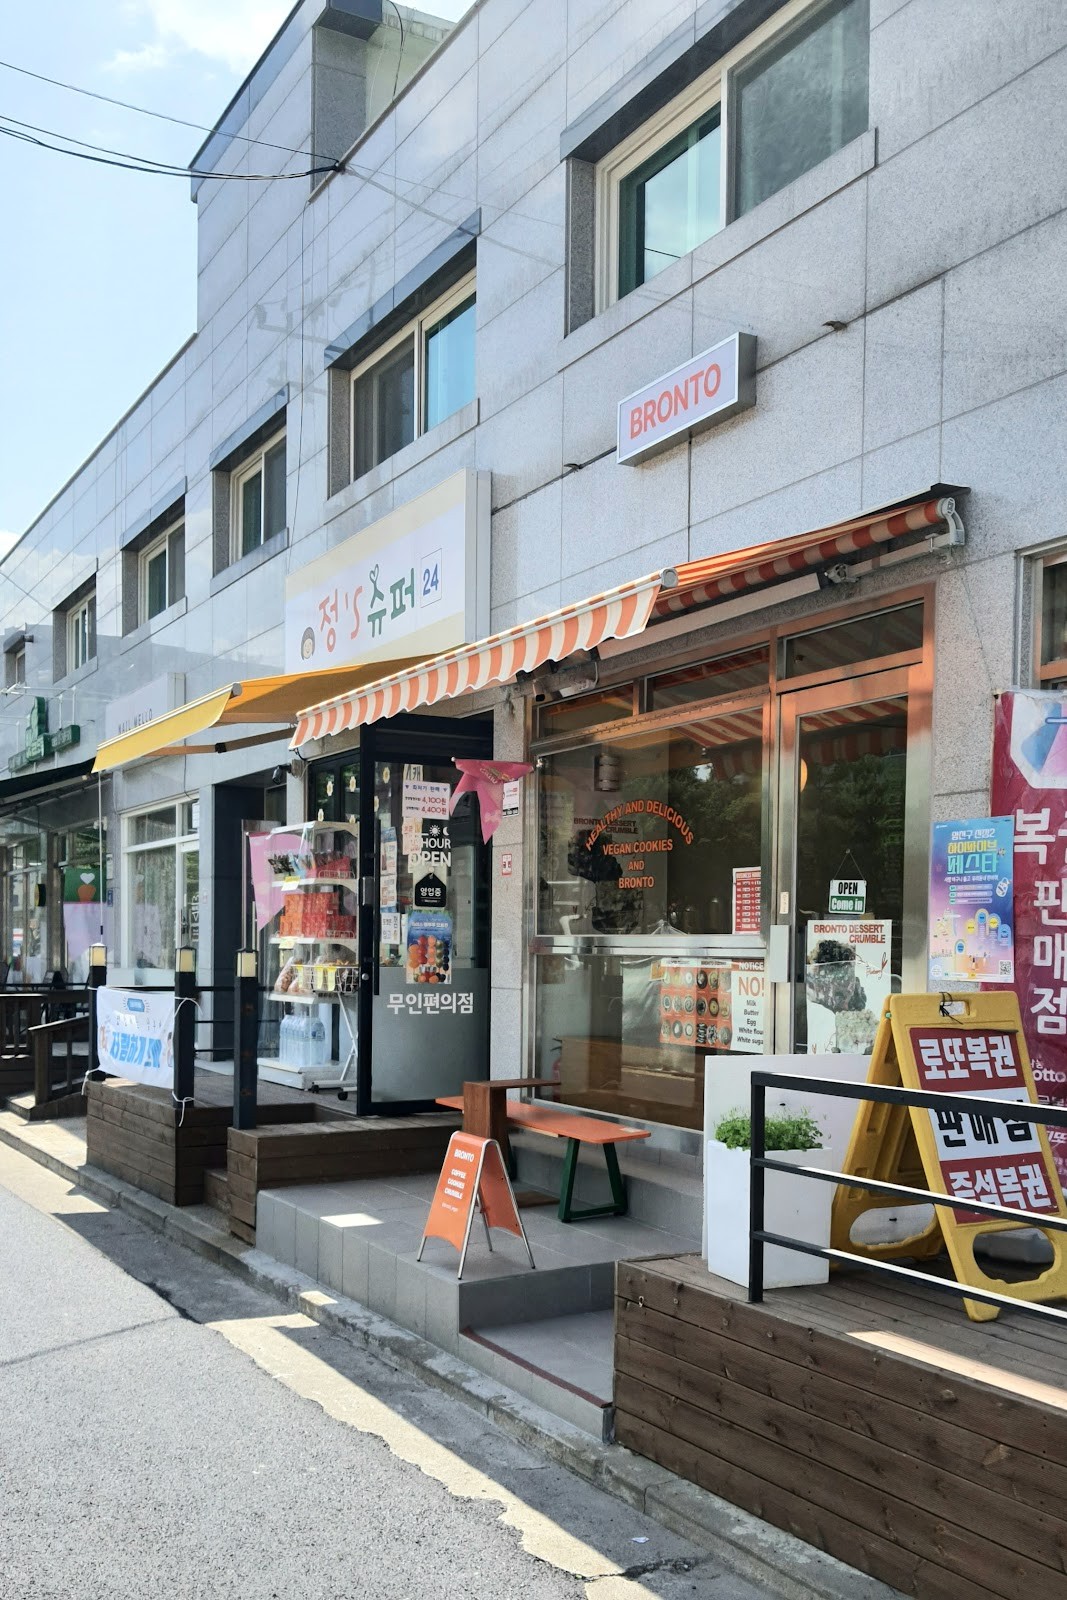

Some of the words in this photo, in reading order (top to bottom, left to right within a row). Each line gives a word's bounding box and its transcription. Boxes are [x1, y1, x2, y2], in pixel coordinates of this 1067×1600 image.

[630, 363, 721, 440] BRONTO
[367, 563, 415, 638] 슈퍼
[422, 563, 439, 596] 24
[585, 804, 624, 851] HEALTHY
[624, 799, 645, 815] AND
[646, 799, 694, 845] DELICIOUS
[421, 837, 451, 849] HOUR
[602, 842, 632, 856] VEGAN
[633, 838, 673, 853] COOKIES
[947, 839, 998, 855] 하이파이브
[409, 850, 451, 867] OPEN
[627, 860, 645, 871] AND
[946, 852, 999, 875] 페스타
[618, 876, 655, 889] BRONTO
[837, 881, 858, 895] OPEN
[420, 887, 442, 897] 영업중
[831, 897, 854, 911] Come
[854, 898, 863, 911] in
[813, 924, 847, 933] BRONTO
[849, 924, 884, 933] DESSERT
[849, 934, 886, 943] CRUMBLE
[738, 962, 764, 970] NOTICE
[738, 976, 764, 997] NO!
[387, 992, 474, 1015] 무인편의점
[743, 1008, 759, 1016] Butter
[746, 1018, 757, 1027] Egg
[738, 1026, 753, 1034] White
[753, 1027, 764, 1035] flou
[736, 1035, 751, 1043] White
[752, 1038, 764, 1046] suga
[918, 1035, 1018, 1080] 로또복권
[1032, 1068, 1066, 1083] otto
[453, 1149, 475, 1163] BRONTO
[451, 1168, 472, 1179] COFFEE
[447, 1177, 470, 1189] COOKIES
[948, 1163, 1052, 1210] 즉석복권
[444, 1187, 468, 1200] CRUMBLE
